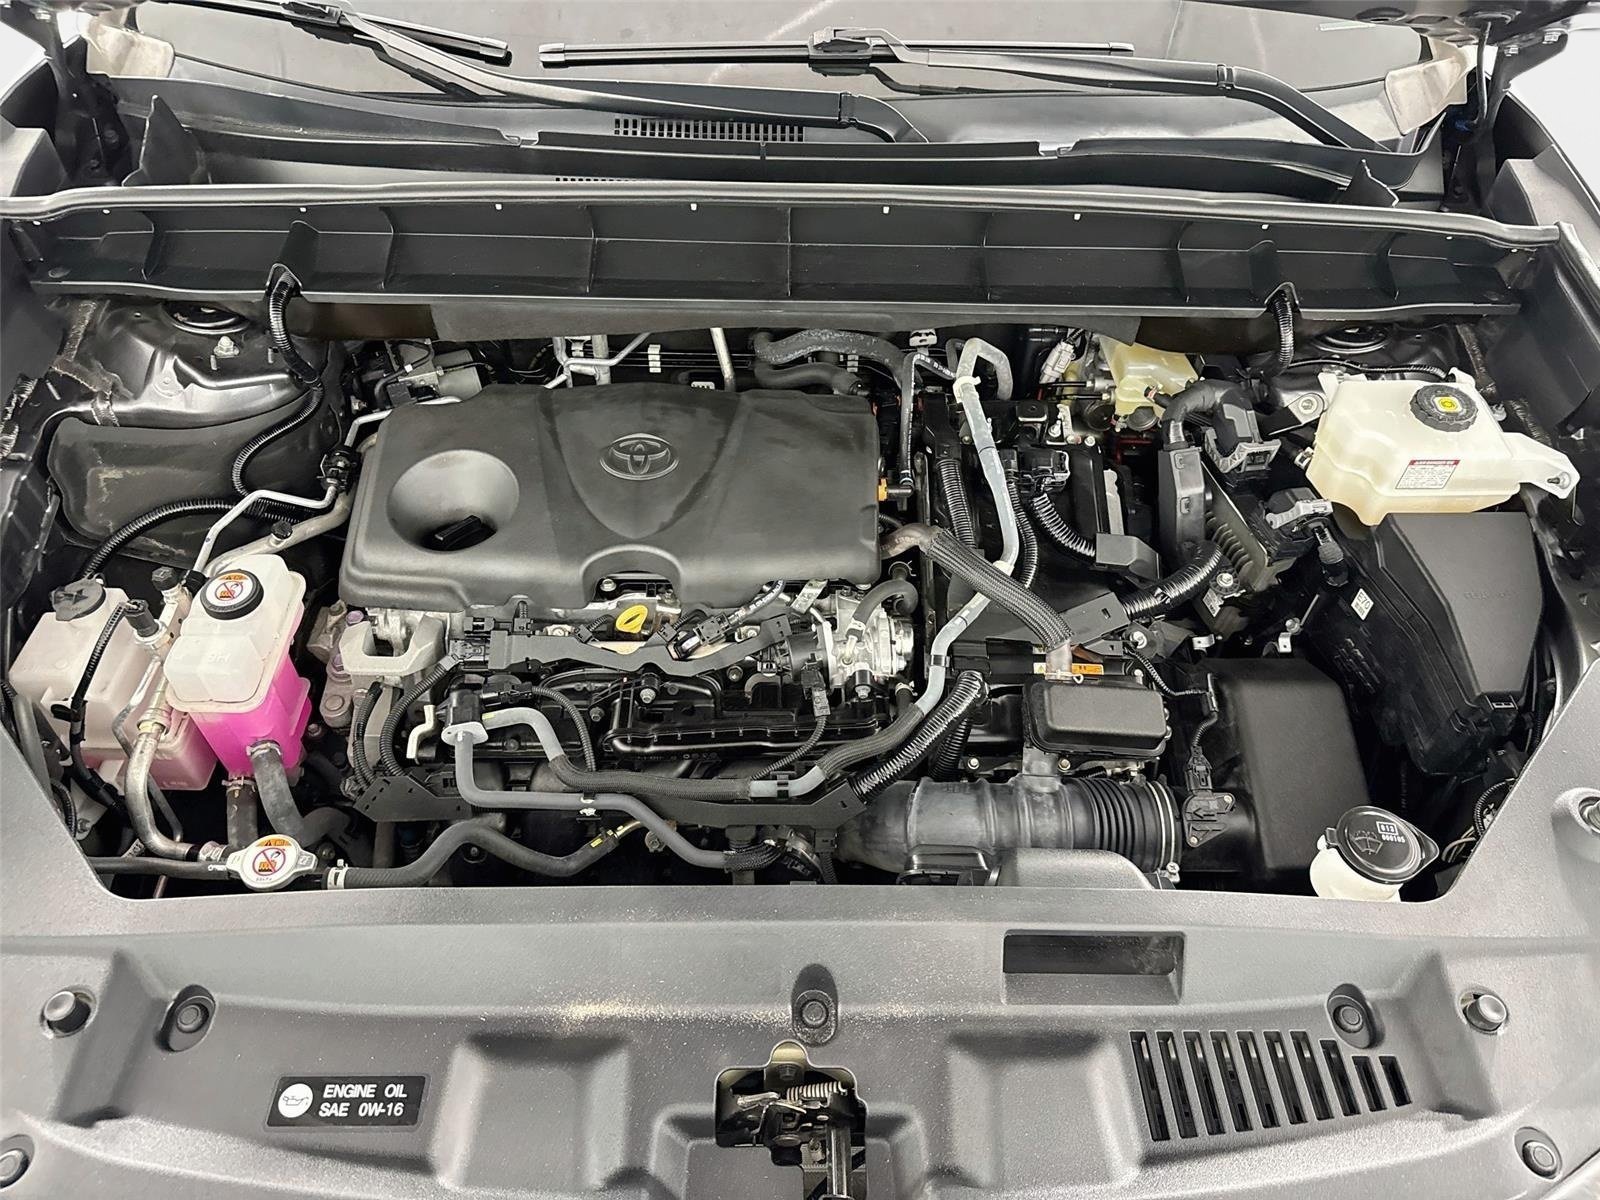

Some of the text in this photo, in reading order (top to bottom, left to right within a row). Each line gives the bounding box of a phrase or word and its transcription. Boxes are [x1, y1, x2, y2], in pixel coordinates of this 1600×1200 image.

[323, 1083, 408, 1098] ENGINE OIL
[318, 1102, 404, 1117] SAE 0W-16
